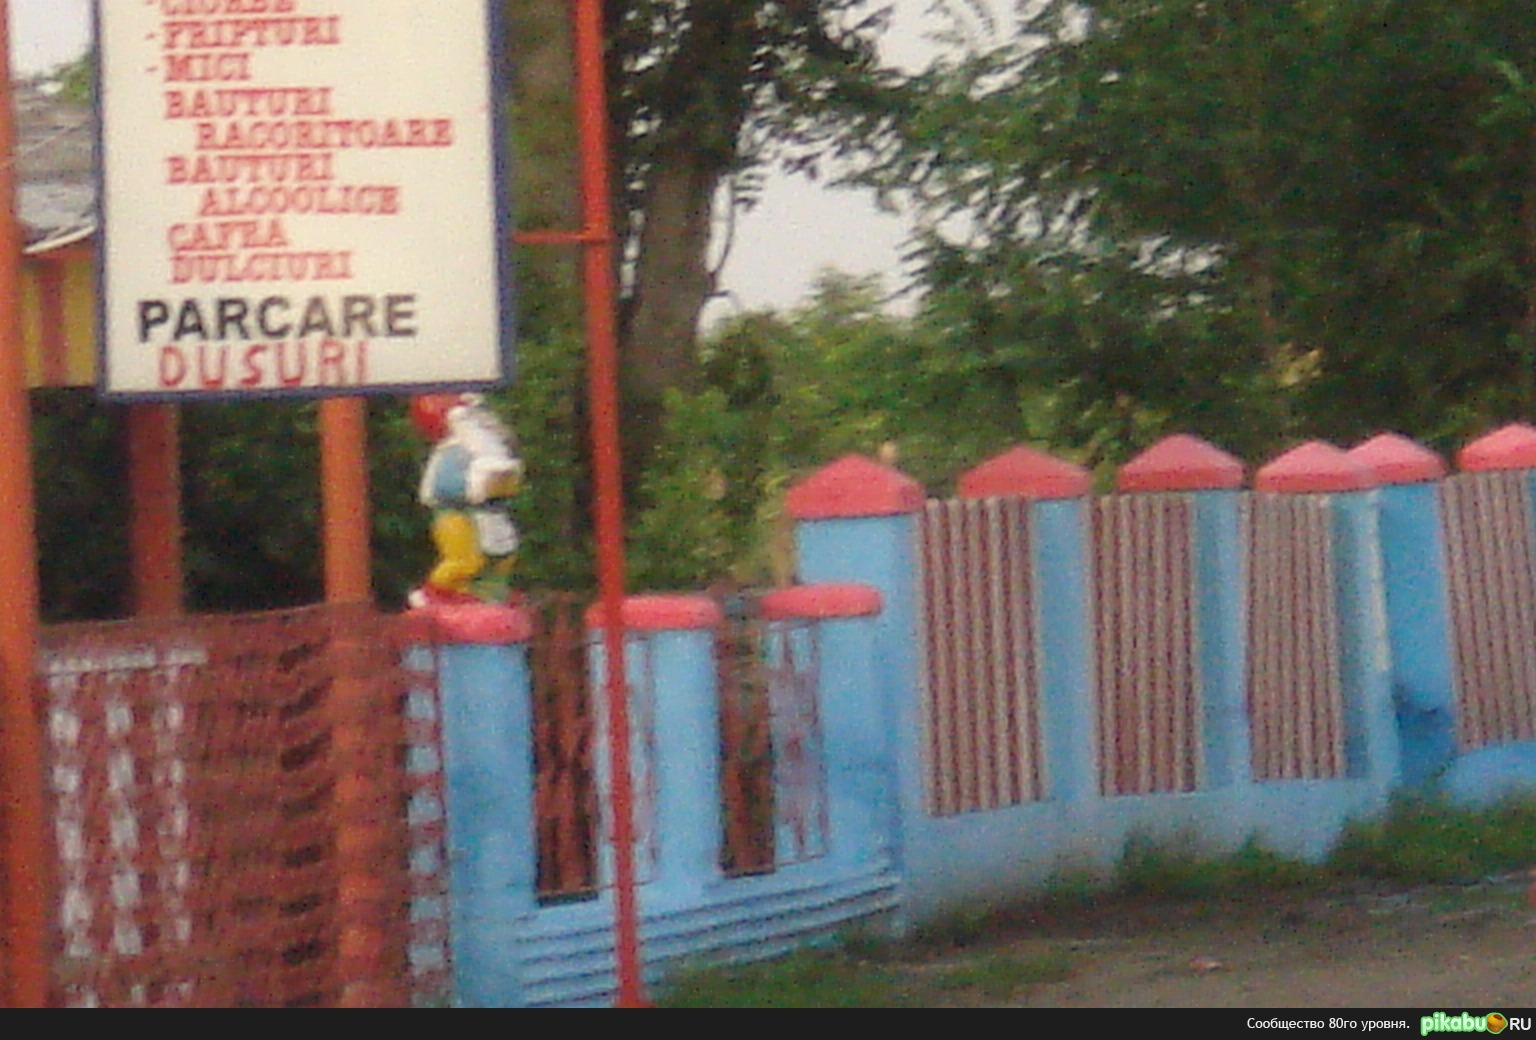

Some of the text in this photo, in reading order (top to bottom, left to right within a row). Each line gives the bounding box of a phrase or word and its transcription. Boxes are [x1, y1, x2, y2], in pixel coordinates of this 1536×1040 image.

[165, 87, 332, 118] BAUTURI
[167, 153, 334, 184] BAUTURI
[199, 186, 399, 216] ALCOOLICE
[167, 219, 289, 251] CAFEA
[170, 251, 352, 283] DULCIURI
[138, 294, 417, 342] PARCARE
[158, 341, 367, 388] DUSURI
